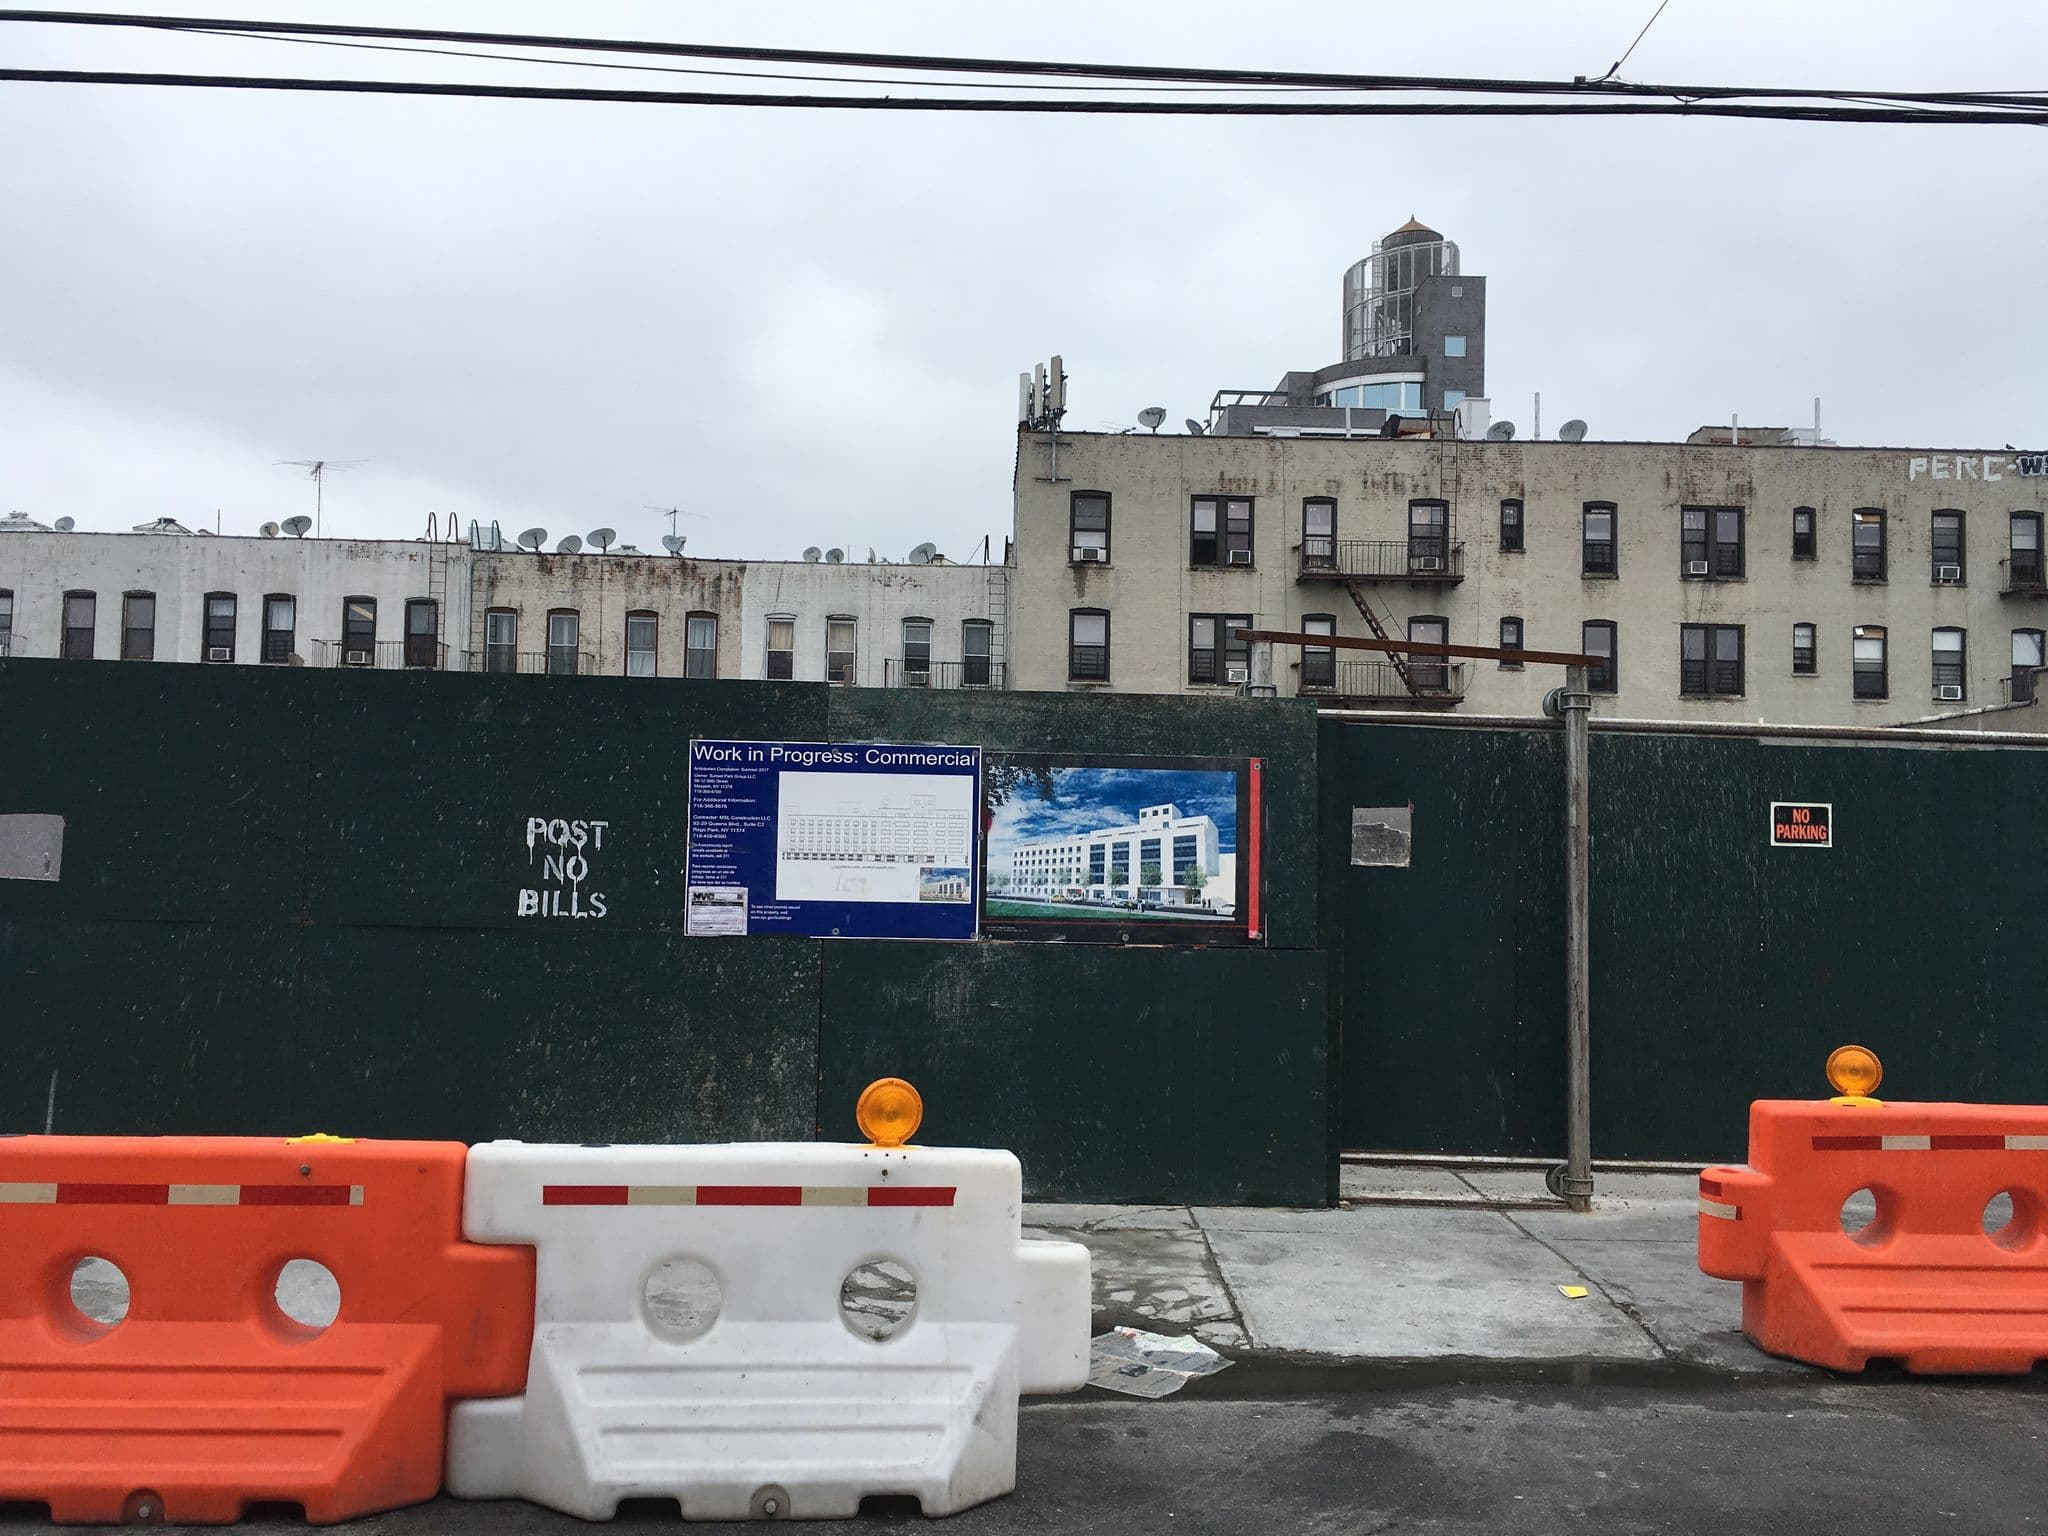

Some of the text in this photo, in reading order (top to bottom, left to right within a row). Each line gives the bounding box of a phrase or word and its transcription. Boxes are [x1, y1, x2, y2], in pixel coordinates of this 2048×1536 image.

[694, 746, 975, 766] Work in Progress: Commercial
[1792, 809, 1810, 824] NO
[527, 817, 609, 851] POST
[1776, 824, 1827, 840] PARKING
[544, 854, 589, 883] NO
[518, 888, 607, 919] BILLS
